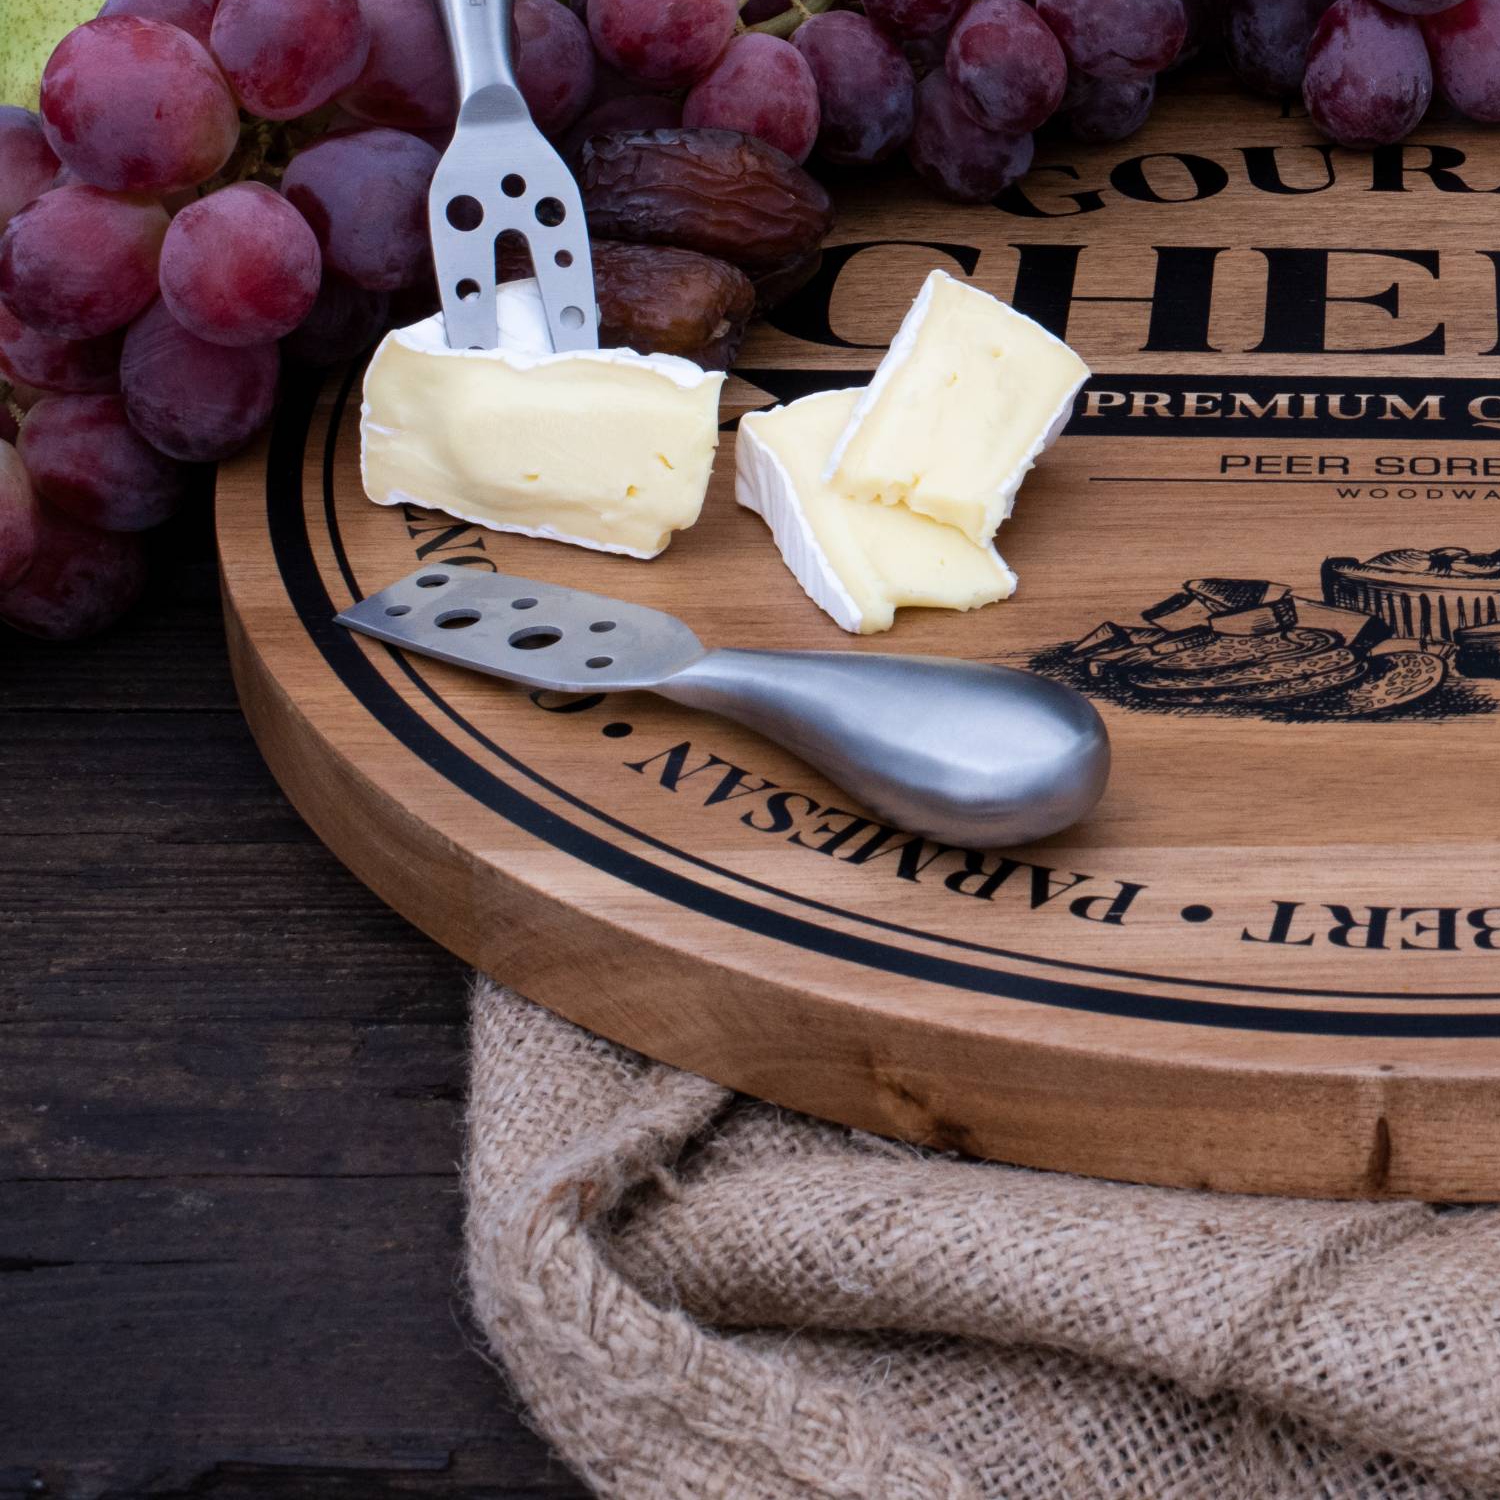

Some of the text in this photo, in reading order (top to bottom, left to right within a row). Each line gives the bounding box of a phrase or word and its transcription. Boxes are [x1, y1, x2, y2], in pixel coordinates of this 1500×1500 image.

[1081, 390, 1446, 420] PREMIUM
[1219, 454, 1350, 476] PEER
[622, 739, 1150, 926] PARMESAN
